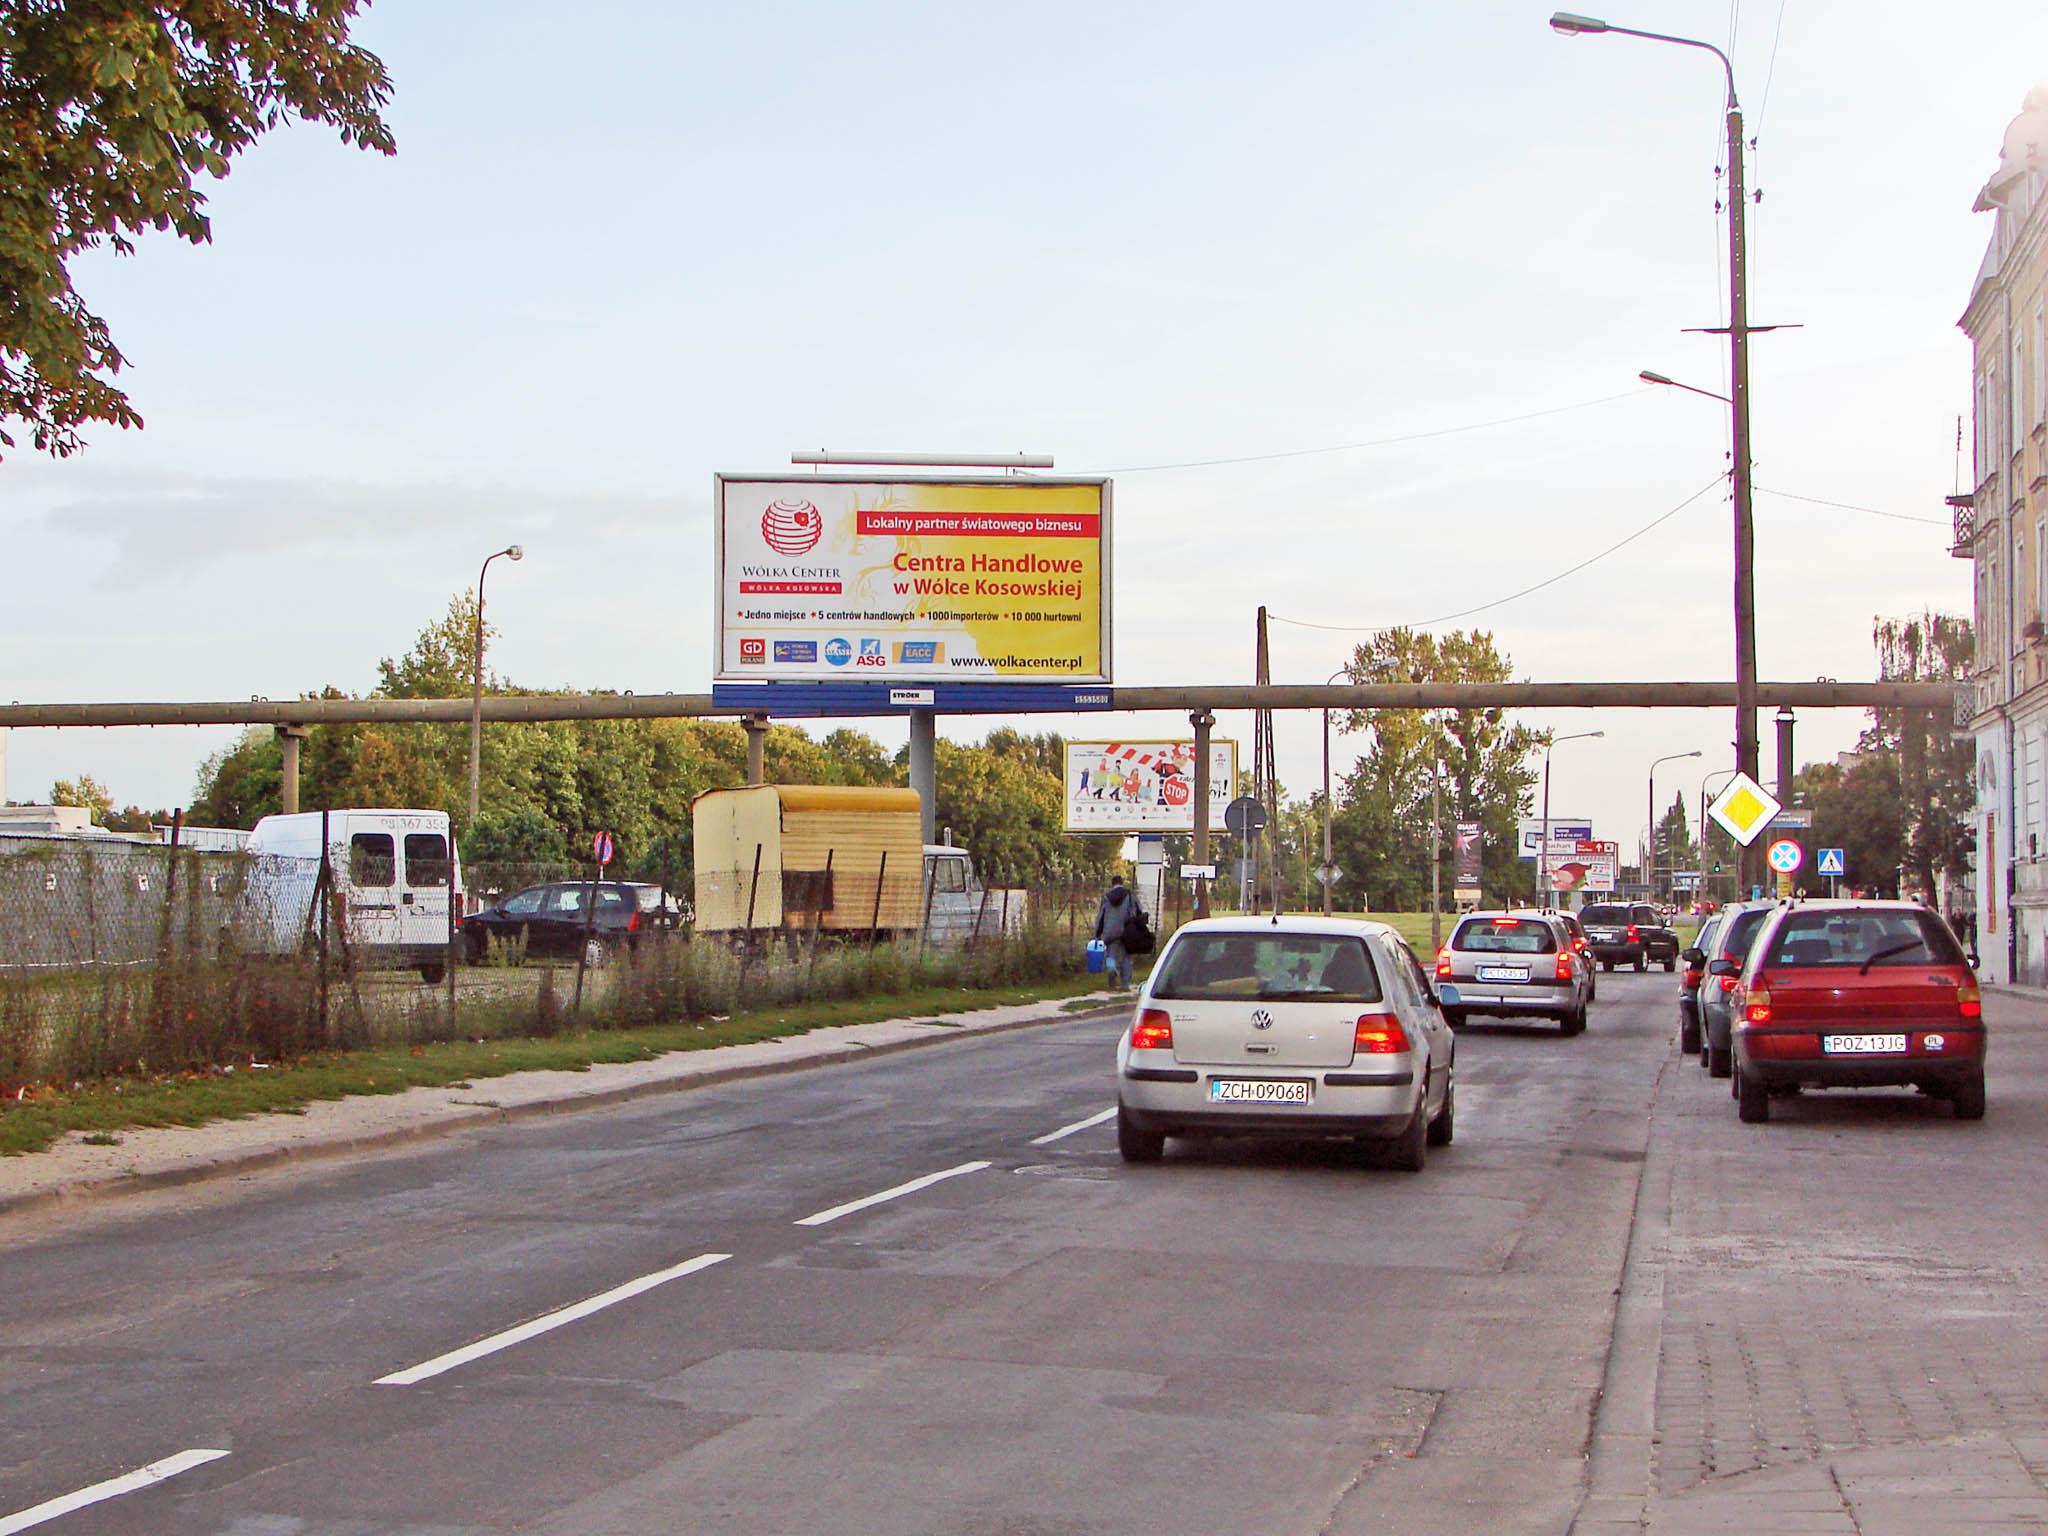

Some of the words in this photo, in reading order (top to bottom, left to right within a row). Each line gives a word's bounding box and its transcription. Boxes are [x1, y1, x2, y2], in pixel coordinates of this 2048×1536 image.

[866, 516, 913, 531] Lokalny
[915, 518, 960, 531] partner
[961, 516, 1033, 533] światowego
[1036, 518, 1081, 531] biznesu
[893, 552, 965, 572] Centra
[971, 553, 1083, 574] Handlowe
[893, 582, 909, 595] w
[913, 578, 969, 595] Wólce
[975, 579, 1082, 600] Kosowskiej
[744, 609, 771, 620] Jedno
[773, 609, 807, 622] miejsce
[818, 610, 824, 620] 5
[826, 610, 861, 620] centrów
[863, 610, 915, 623] handlowych
[928, 611, 950, 621] 1000
[950, 611, 999, 622] importerów
[1011, 612, 1022, 621] 10
[1024, 612, 1042, 621] 000
[1043, 612, 1082, 622] hurtowni
[743, 641, 763, 654] GD
[856, 656, 886, 667] ASG
[950, 655, 1082, 671] www.wolkacenter.pl
[1165, 783, 1187, 800] STOP
[1833, 1037, 1864, 1051] POZ
[1870, 1036, 1905, 1050] 13JG
[1220, 1083, 1251, 1098] ZCH
[1256, 1084, 1305, 1100] 09068
